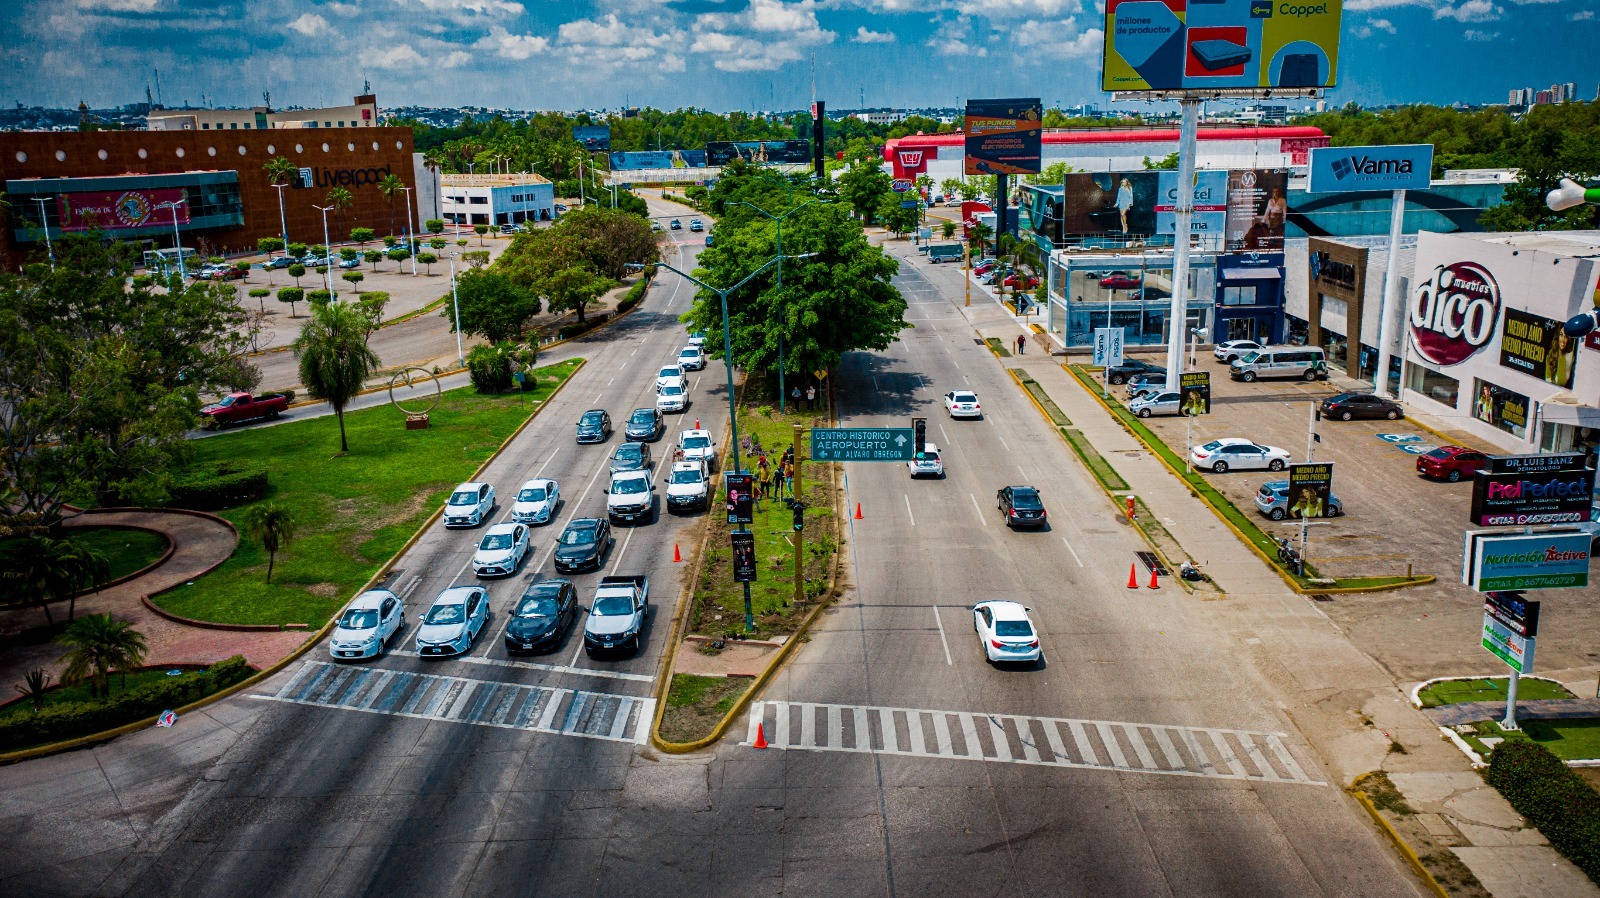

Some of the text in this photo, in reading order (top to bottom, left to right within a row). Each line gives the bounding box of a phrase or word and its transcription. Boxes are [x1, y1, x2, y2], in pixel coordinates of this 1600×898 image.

[1279, 3, 1329, 18] Coppel
[1117, 17, 1152, 25] millones
[1117, 25, 1171, 35] de productos
[1350, 155, 1413, 175] Vama
[315, 164, 391, 188] Liverpool
[1168, 188, 1211, 200] Ctel
[1453, 277, 1490, 294] muebles
[1412, 265, 1495, 346] dico
[1507, 319, 1528, 339] MEDIO
[1528, 321, 1543, 344] AÑO
[1501, 335, 1521, 355] MEDIO
[1521, 341, 1545, 363] PRECIO
[815, 431, 891, 440] CENTRO HISTORICO
[817, 441, 887, 449] AEROPUERTO
[845, 450, 870, 458] ALVARO
[873, 450, 902, 458] OBREGON
[1506, 457, 1574, 467] DR. LUIS SANZ
[1488, 516, 1515, 525] CITAS
[1487, 580, 1512, 588] CITAS
